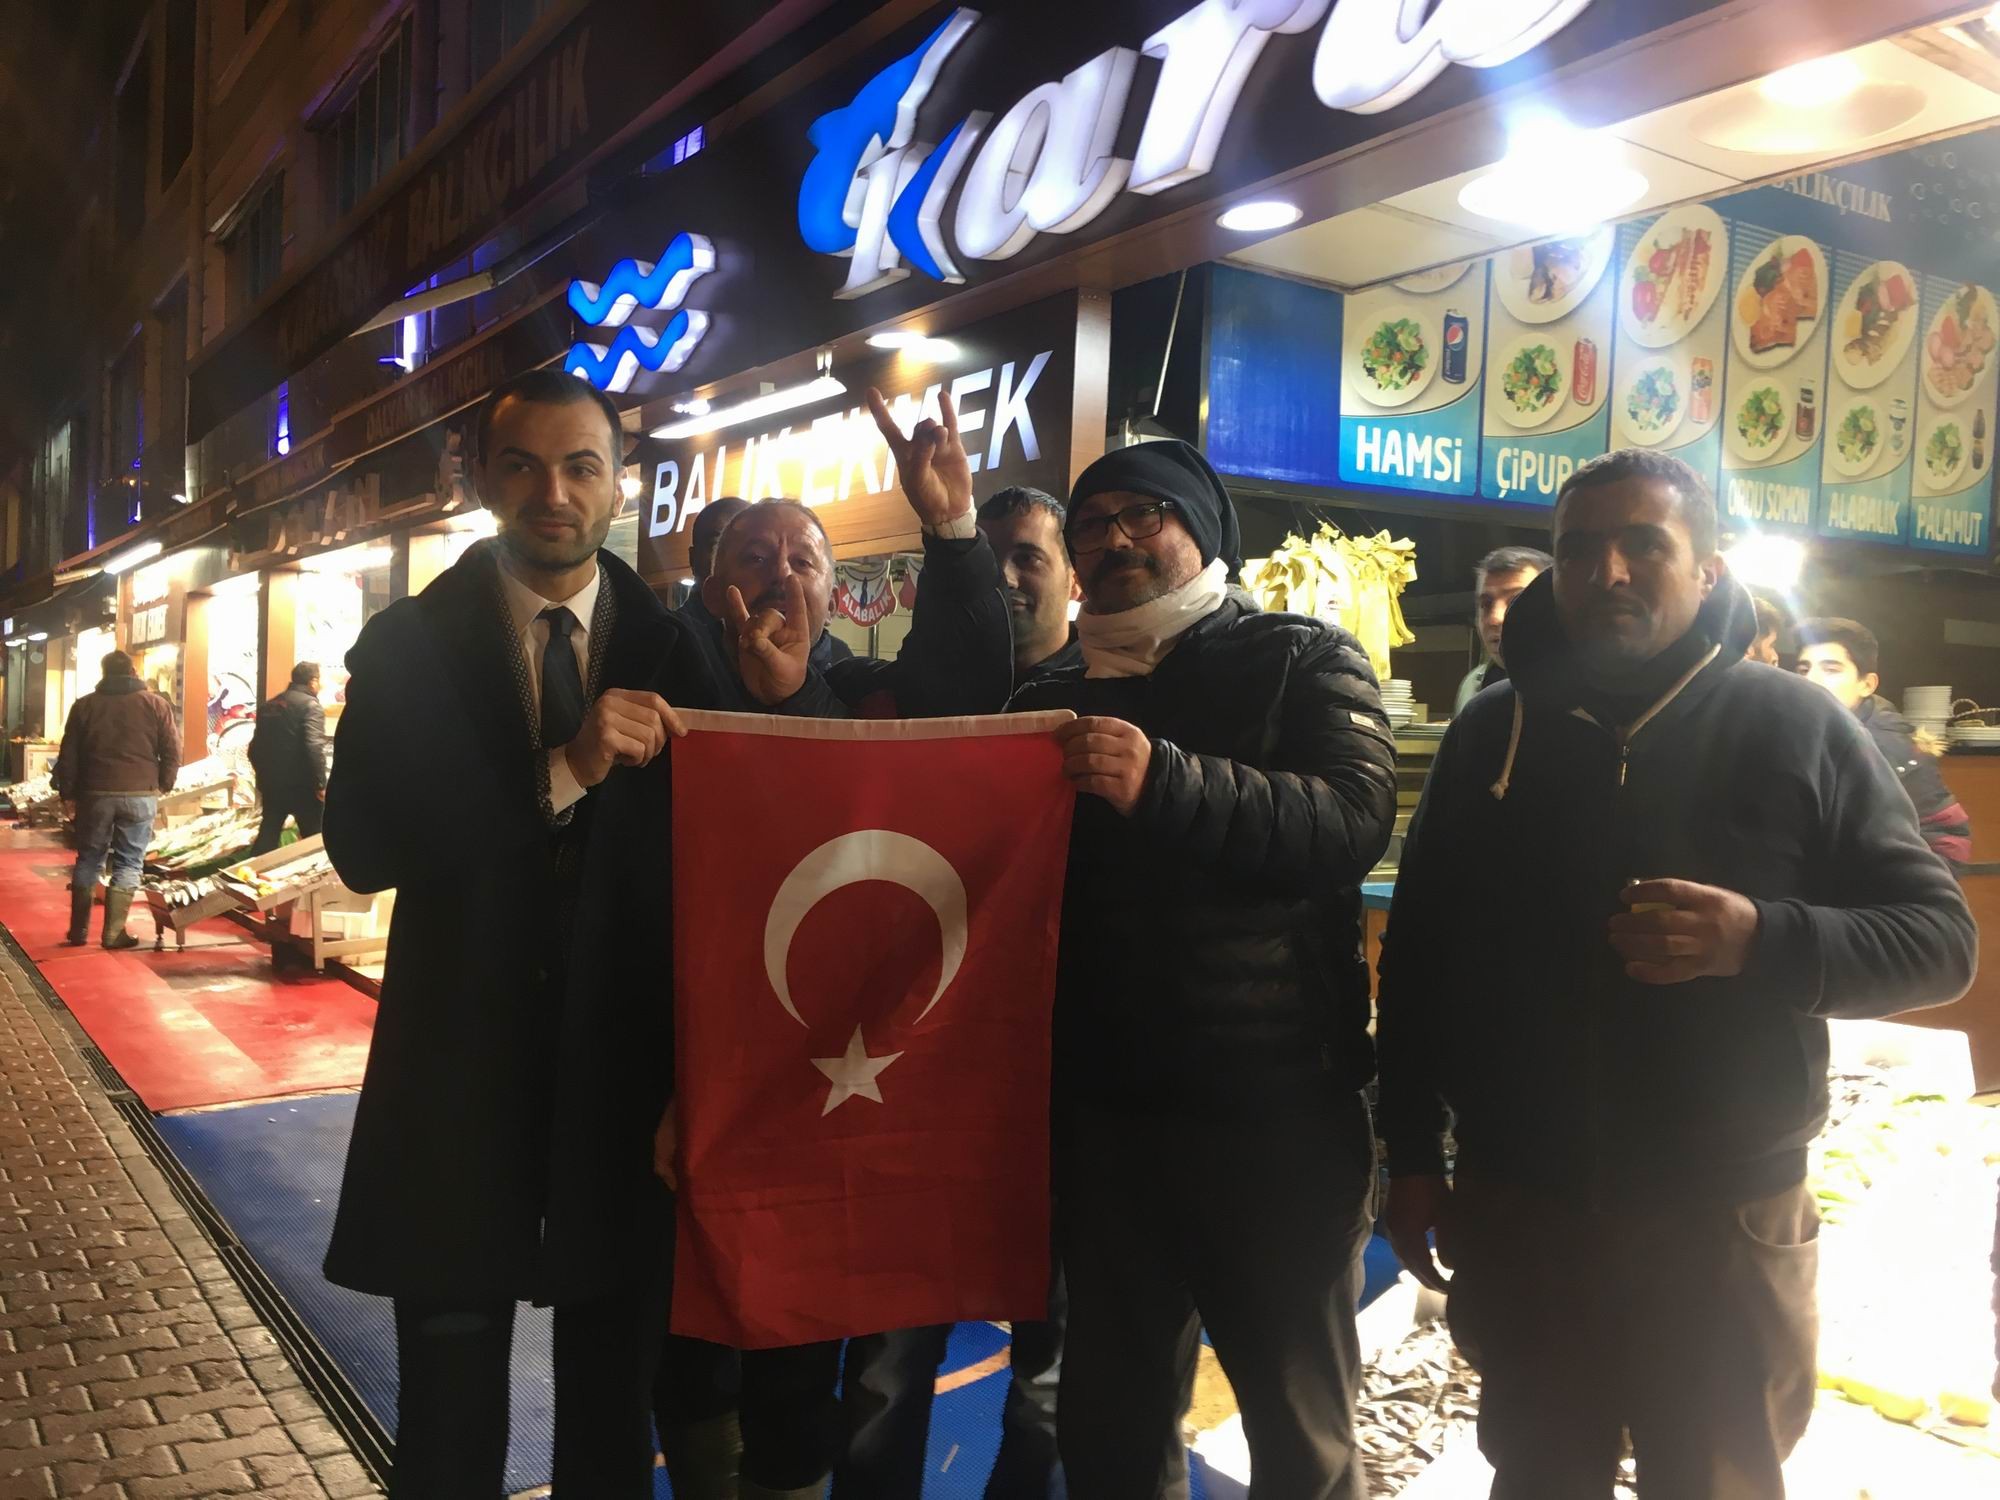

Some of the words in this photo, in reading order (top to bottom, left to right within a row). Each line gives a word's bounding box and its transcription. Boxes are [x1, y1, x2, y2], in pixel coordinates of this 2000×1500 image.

[1727, 478, 1764, 520] ORDU
[1765, 482, 1811, 525] SOMON
[1828, 491, 1900, 536] ALABALIK
[1917, 503, 1983, 547] PALAMUT
[842, 588, 891, 622] ALABALIK
